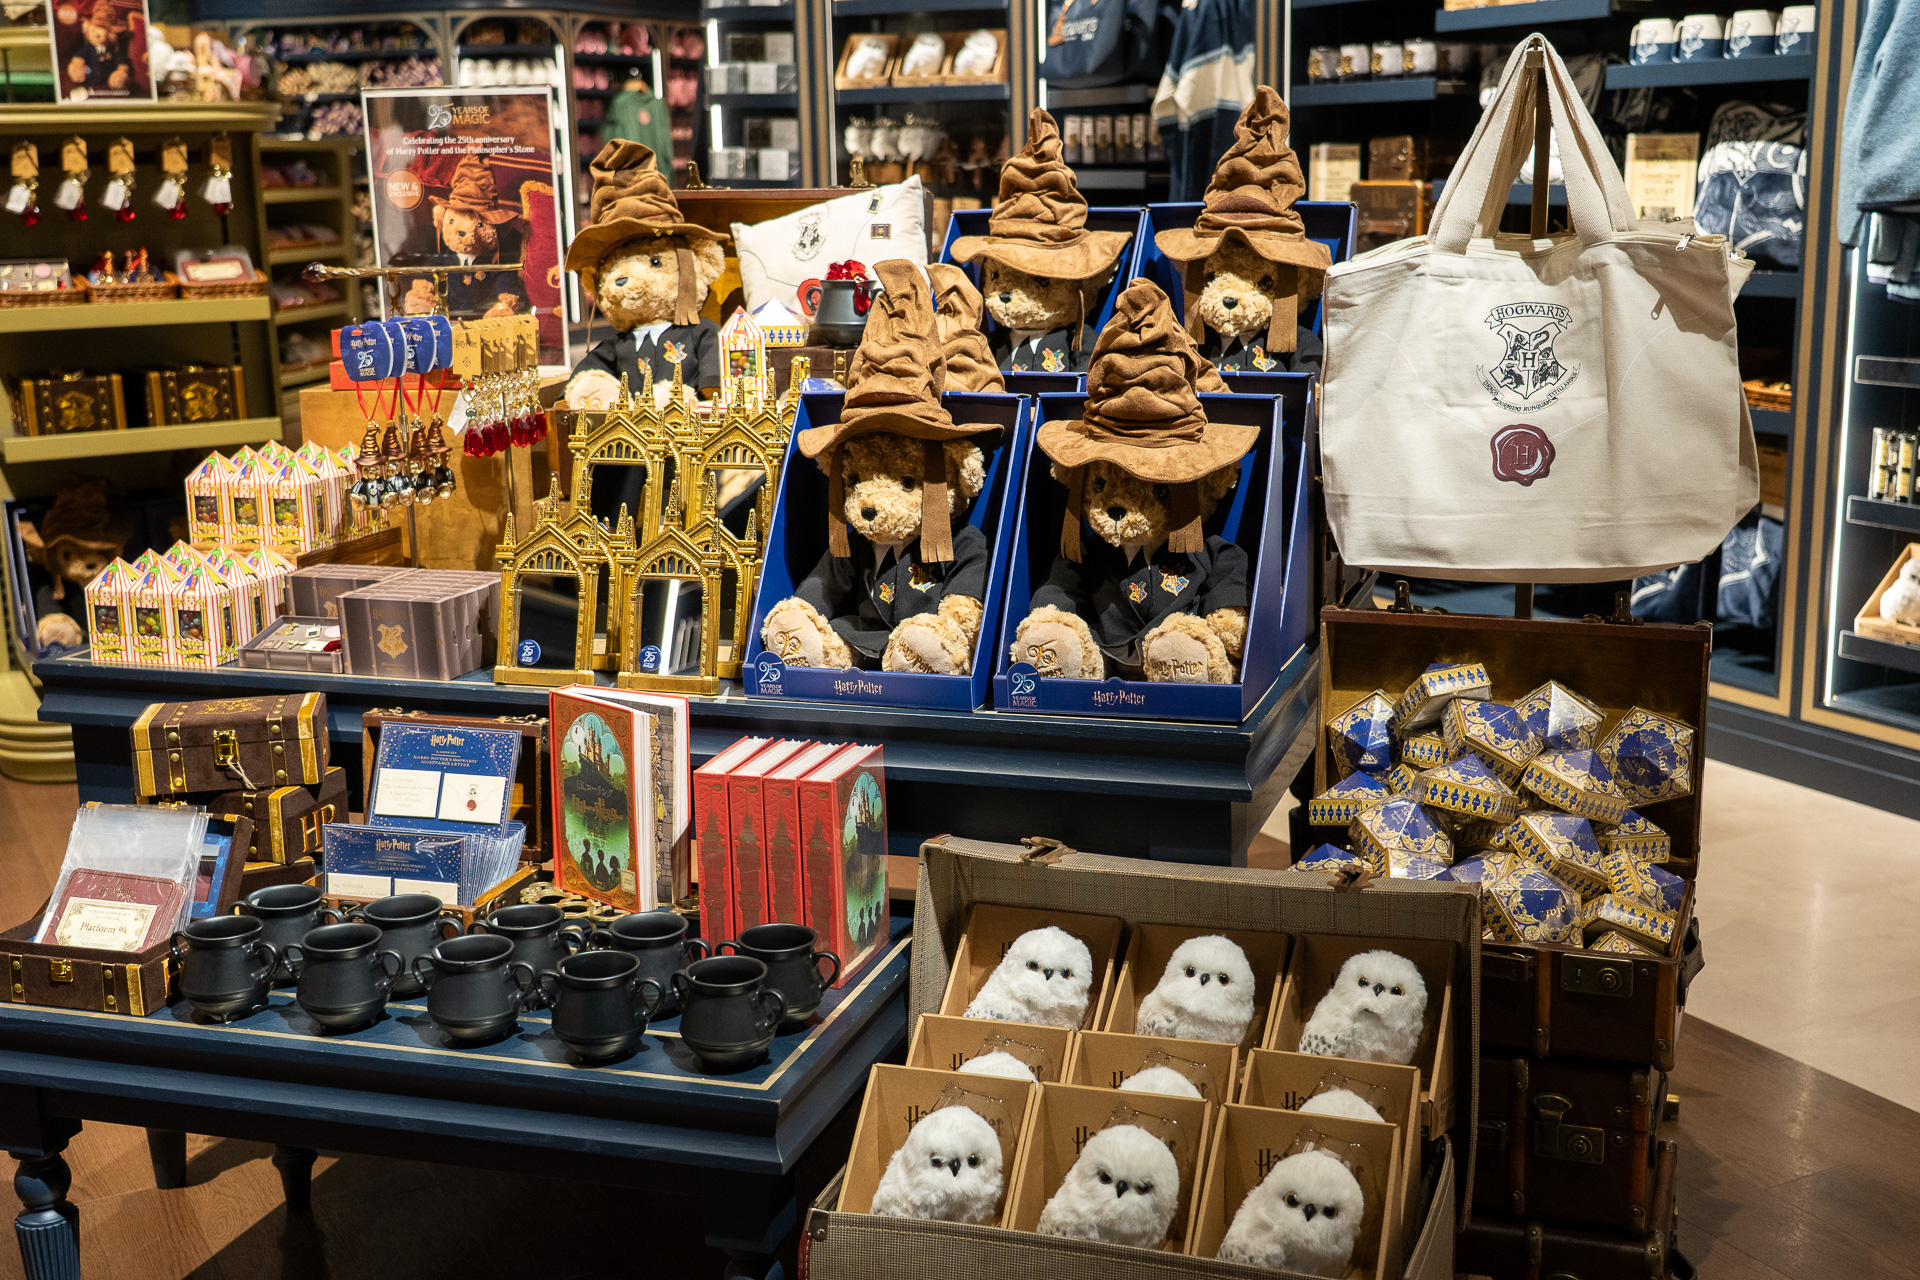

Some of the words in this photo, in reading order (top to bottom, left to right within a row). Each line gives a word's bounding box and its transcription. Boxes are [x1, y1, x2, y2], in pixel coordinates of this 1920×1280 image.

[452, 114, 490, 124] MAGIC
[403, 137, 443, 146] Celebrating
[444, 136, 456, 144] the
[457, 136, 474, 144] 25th
[475, 136, 515, 144] anniversary
[396, 148, 416, 157] Harry
[417, 147, 439, 155] Potter
[467, 146, 513, 155] Philosopher's
[389, 182, 410, 190] NEW
[411, 182, 419, 190] &
[1495, 304, 1566, 319] HOGWARTS
[1522, 352, 1537, 369] H
[1483, 379, 1499, 396] DRACO
[1514, 444, 1530, 465] H
[758, 661, 782, 683] 25
[1170, 658, 1203, 680] Potter
[760, 687, 784, 695] MAGIC
[834, 680, 858, 696] Harry
[857, 679, 883, 695] Potter
[1011, 672, 1037, 695] 25
[1012, 700, 1037, 708] MAGIC
[1092, 690, 1118, 706] Harry
[1118, 689, 1146, 706] Potter
[430, 735, 447, 747] Harry
[447, 734, 465, 748] Potter
[299, 803, 336, 853] HP
[376, 838, 392, 851] Harry
[392, 838, 411, 852] Potter
[80, 921, 116, 934] Platform
